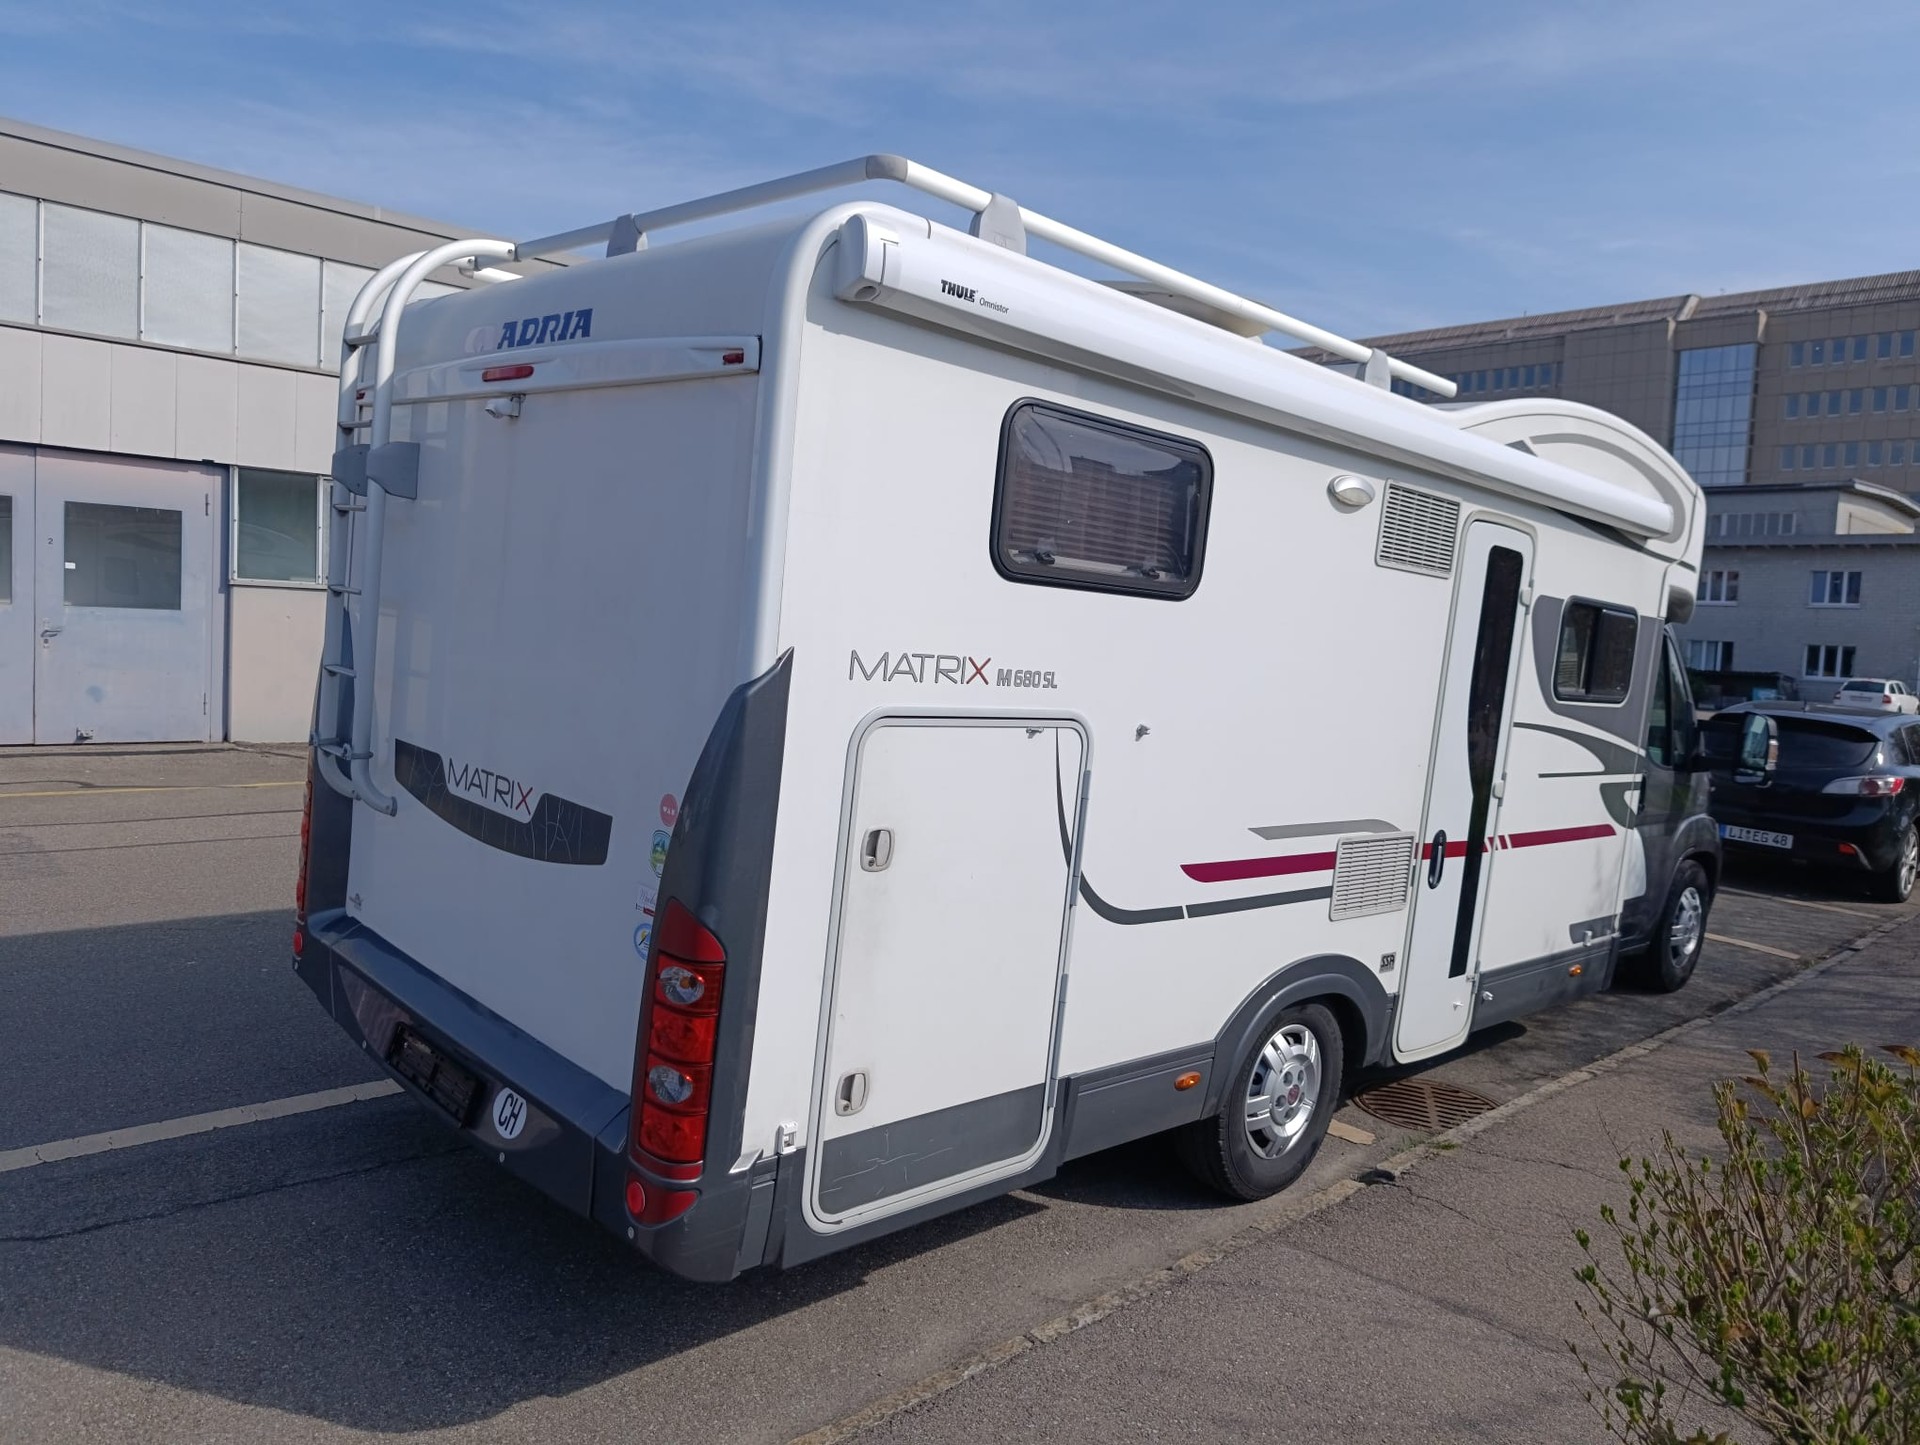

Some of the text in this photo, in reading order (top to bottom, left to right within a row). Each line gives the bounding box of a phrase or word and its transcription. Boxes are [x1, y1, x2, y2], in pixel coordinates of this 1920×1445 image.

[941, 279, 1010, 314] THULE Omnistor
[497, 308, 593, 350] ADRIA
[48, 537, 54, 545] 2
[849, 649, 991, 685] MATRIX
[447, 757, 533, 816] MATRIX
[1728, 827, 1788, 846] LI EG 48
[498, 1092, 524, 1136] CH
